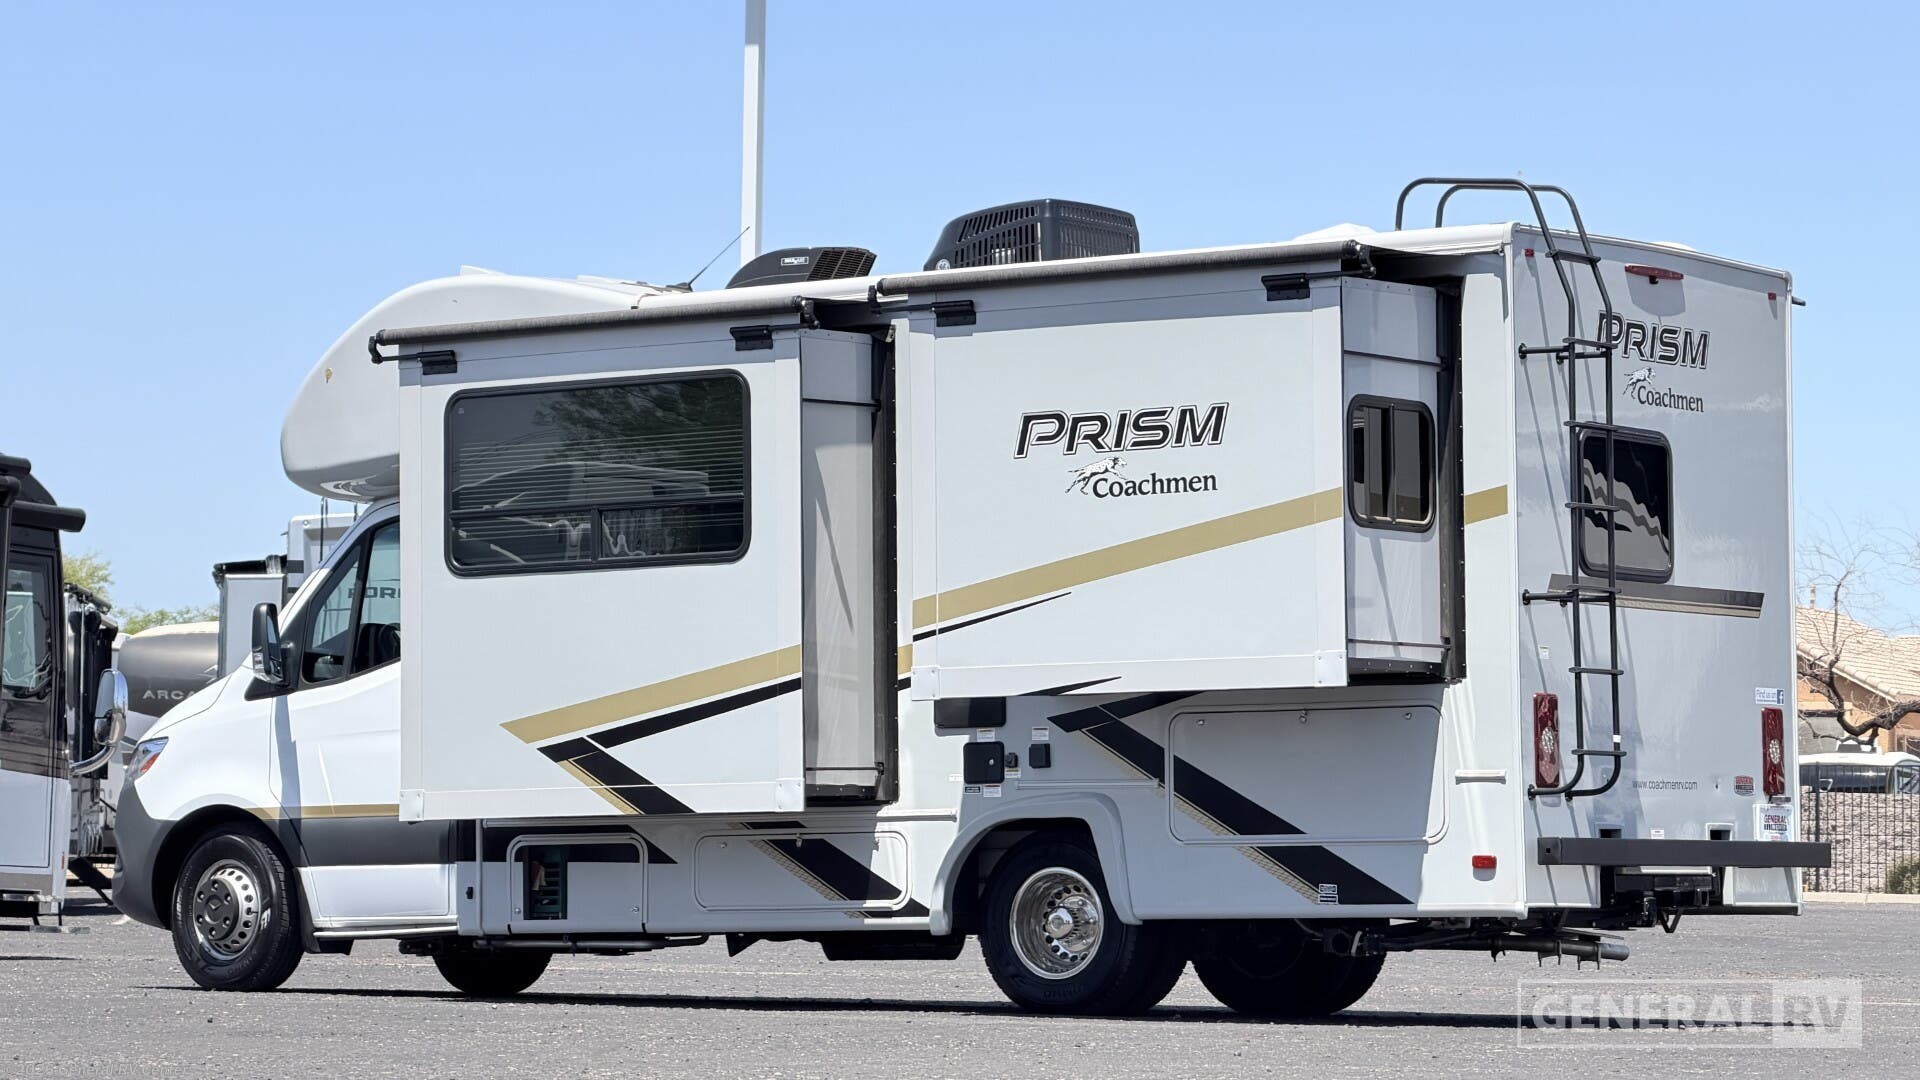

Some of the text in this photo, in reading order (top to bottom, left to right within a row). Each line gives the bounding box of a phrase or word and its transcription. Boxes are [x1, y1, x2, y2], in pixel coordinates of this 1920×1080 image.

[1597, 310, 1710, 369] PRISM
[1637, 385, 1704, 412] Coachmen
[1014, 402, 1229, 459] PRISM
[1092, 472, 1218, 498] Coachmen
